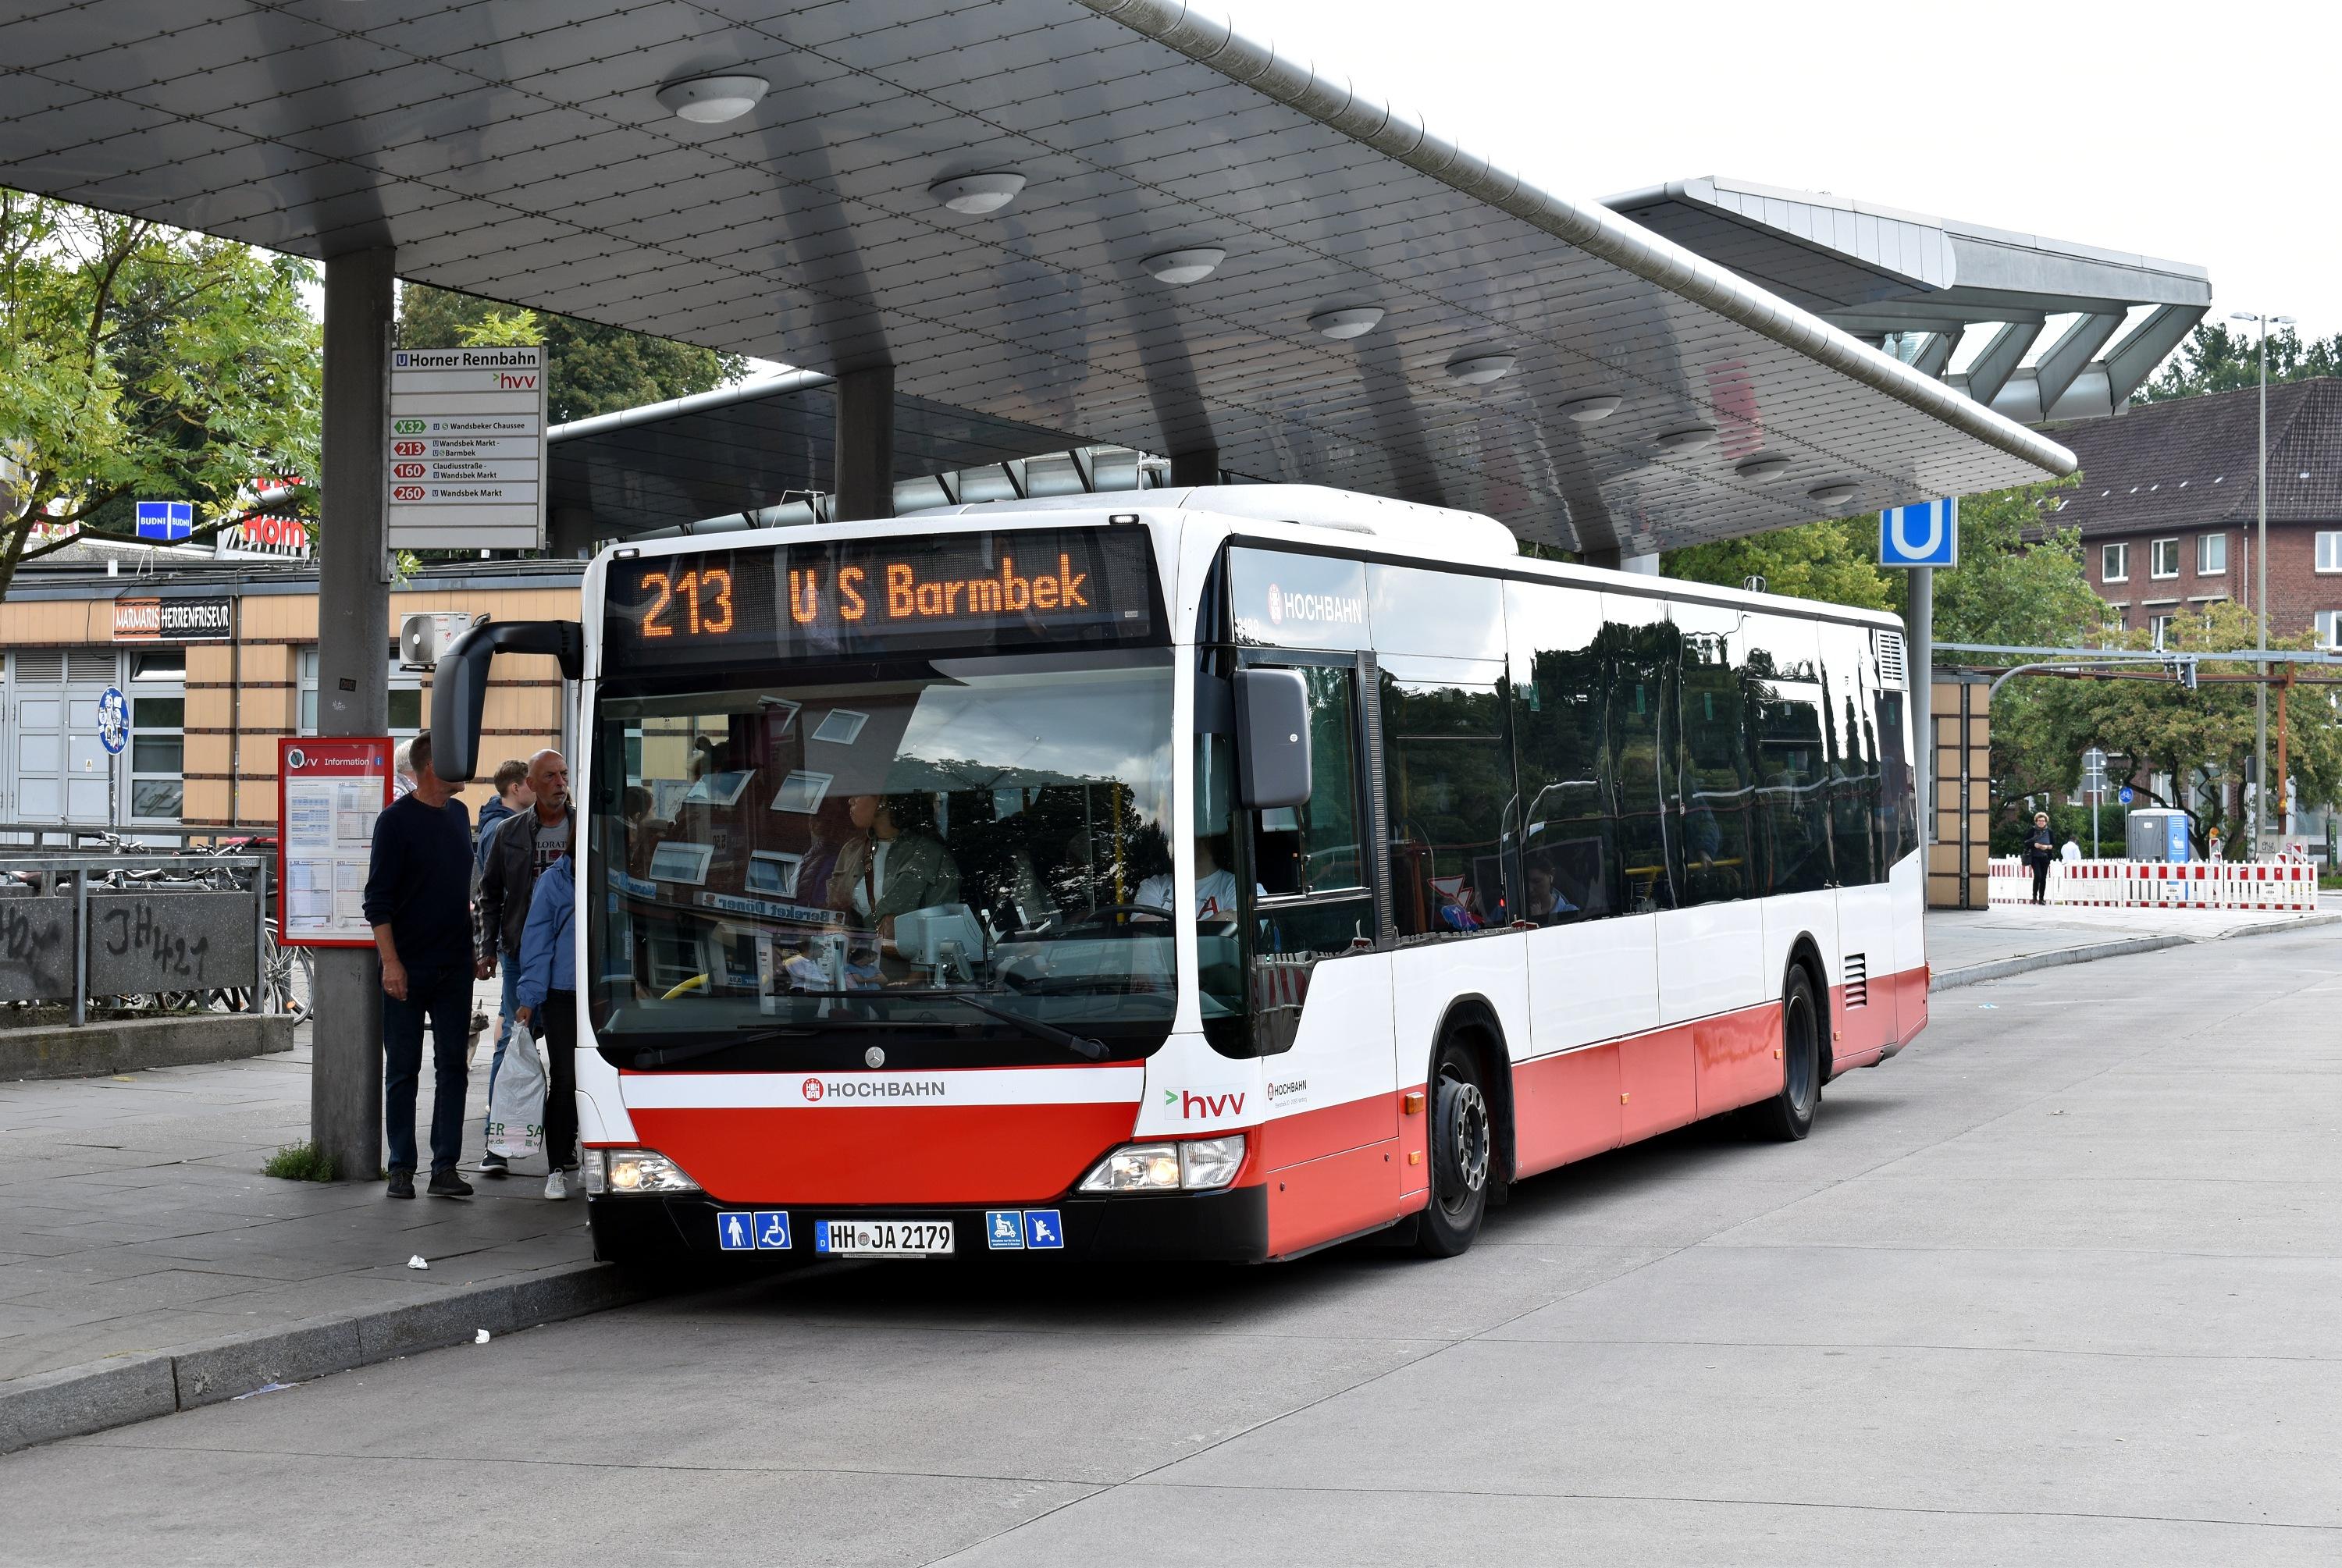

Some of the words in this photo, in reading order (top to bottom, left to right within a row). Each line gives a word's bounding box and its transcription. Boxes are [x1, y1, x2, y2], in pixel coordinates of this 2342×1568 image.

[410, 354, 459, 367] Horner
[463, 351, 536, 365] Rennbahn
[500, 373, 536, 389] hvv
[399, 421, 422, 433] X32
[399, 443, 422, 455] 213
[399, 464, 422, 477] 160
[398, 487, 422, 500] 260
[141, 517, 166, 525] BUDNI
[172, 517, 190, 527] BUDNI
[1892, 500, 1942, 560] U
[641, 568, 733, 637] 213
[789, 570, 817, 624] U
[839, 567, 866, 621] S
[888, 553, 1088, 618] Barmbek
[1284, 592, 1362, 624] HOCHBAHN
[116, 607, 160, 629] MARMARIS
[828, 1081, 945, 1097] HOCHBAHN
[1274, 1079, 1308, 1097] HOCHBAHN
[1183, 1090, 1246, 1119] hvv
[831, 1225, 856, 1248] HH
[872, 1225, 896, 1249] JA
[902, 1225, 950, 1249] 2179
